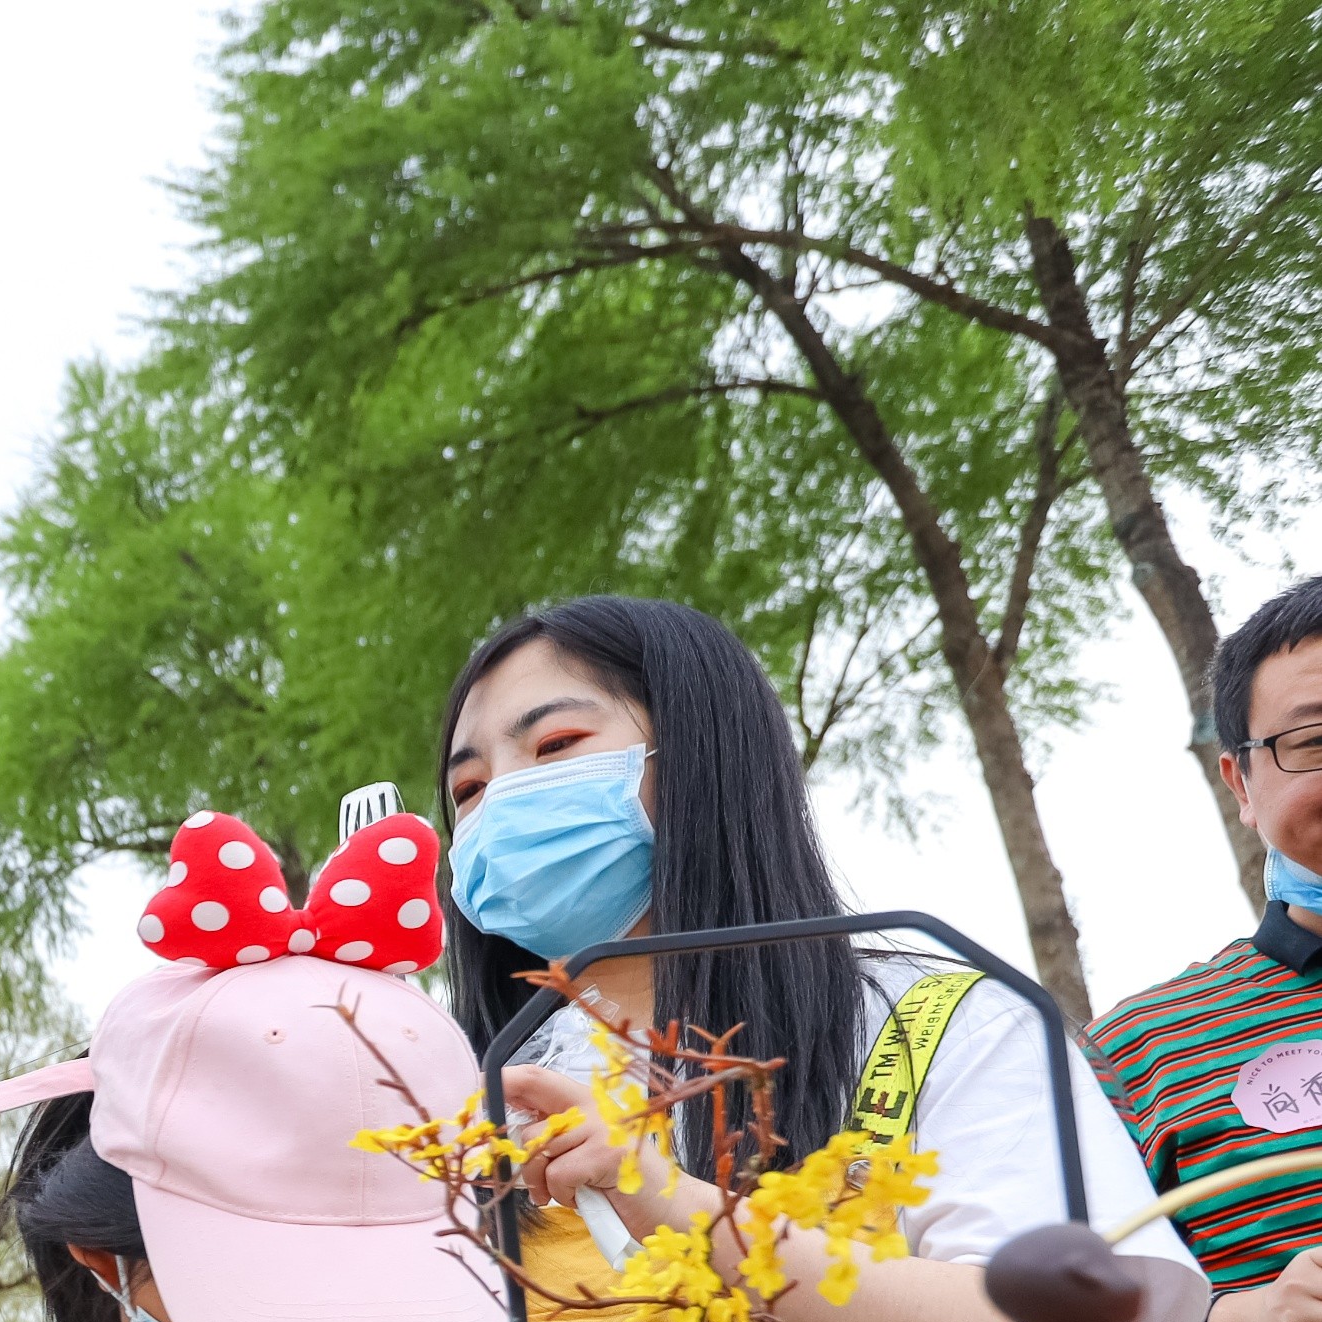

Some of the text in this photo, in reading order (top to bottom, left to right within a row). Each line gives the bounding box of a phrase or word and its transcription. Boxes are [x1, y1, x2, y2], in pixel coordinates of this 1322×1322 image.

[1246, 1067, 1262, 1086] NICE
[1261, 1057, 1274, 1067] TO
[1276, 1048, 1302, 1059] MEET
